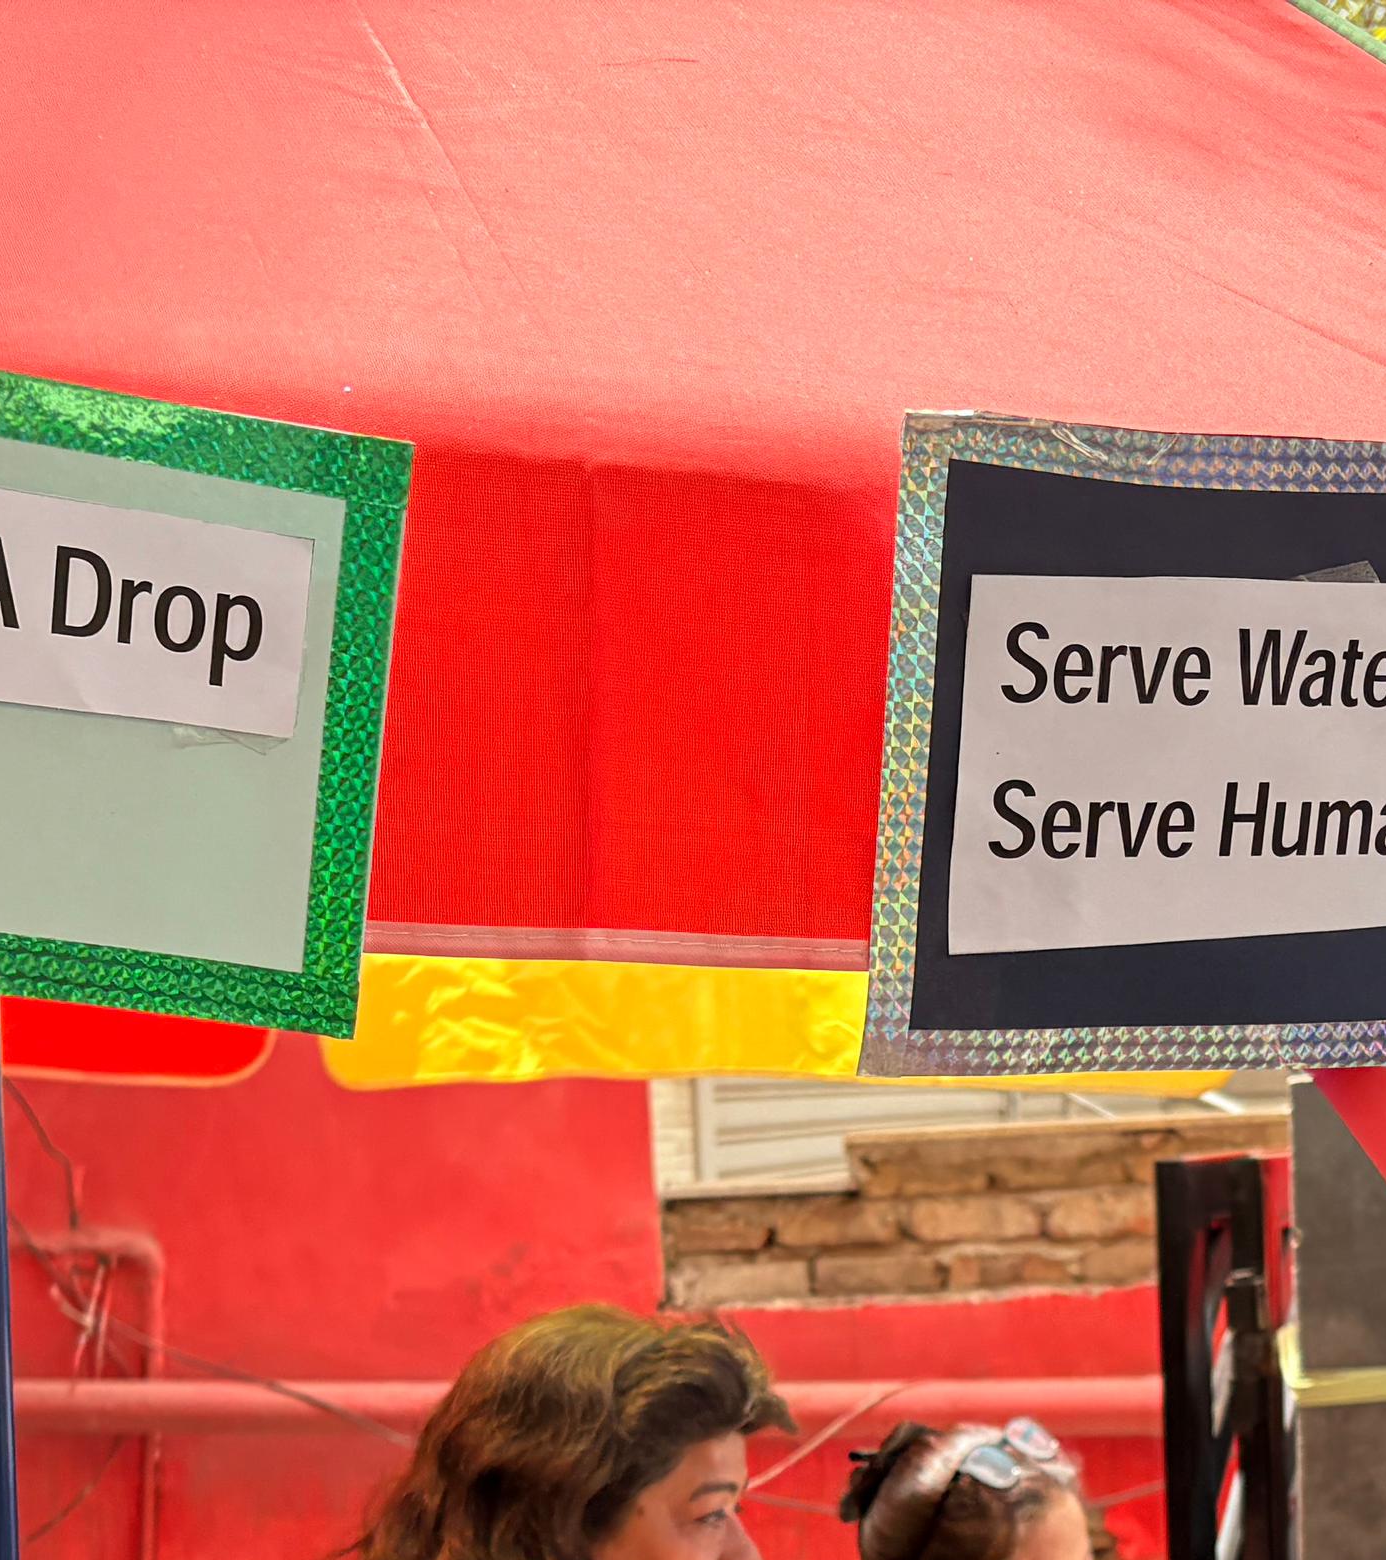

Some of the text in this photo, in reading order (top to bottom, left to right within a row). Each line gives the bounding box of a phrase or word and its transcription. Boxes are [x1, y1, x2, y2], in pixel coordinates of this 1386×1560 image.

[50, 544, 264, 688] Drop
[999, 620, 1212, 708] Serve
[987, 778, 1196, 861] Serve
